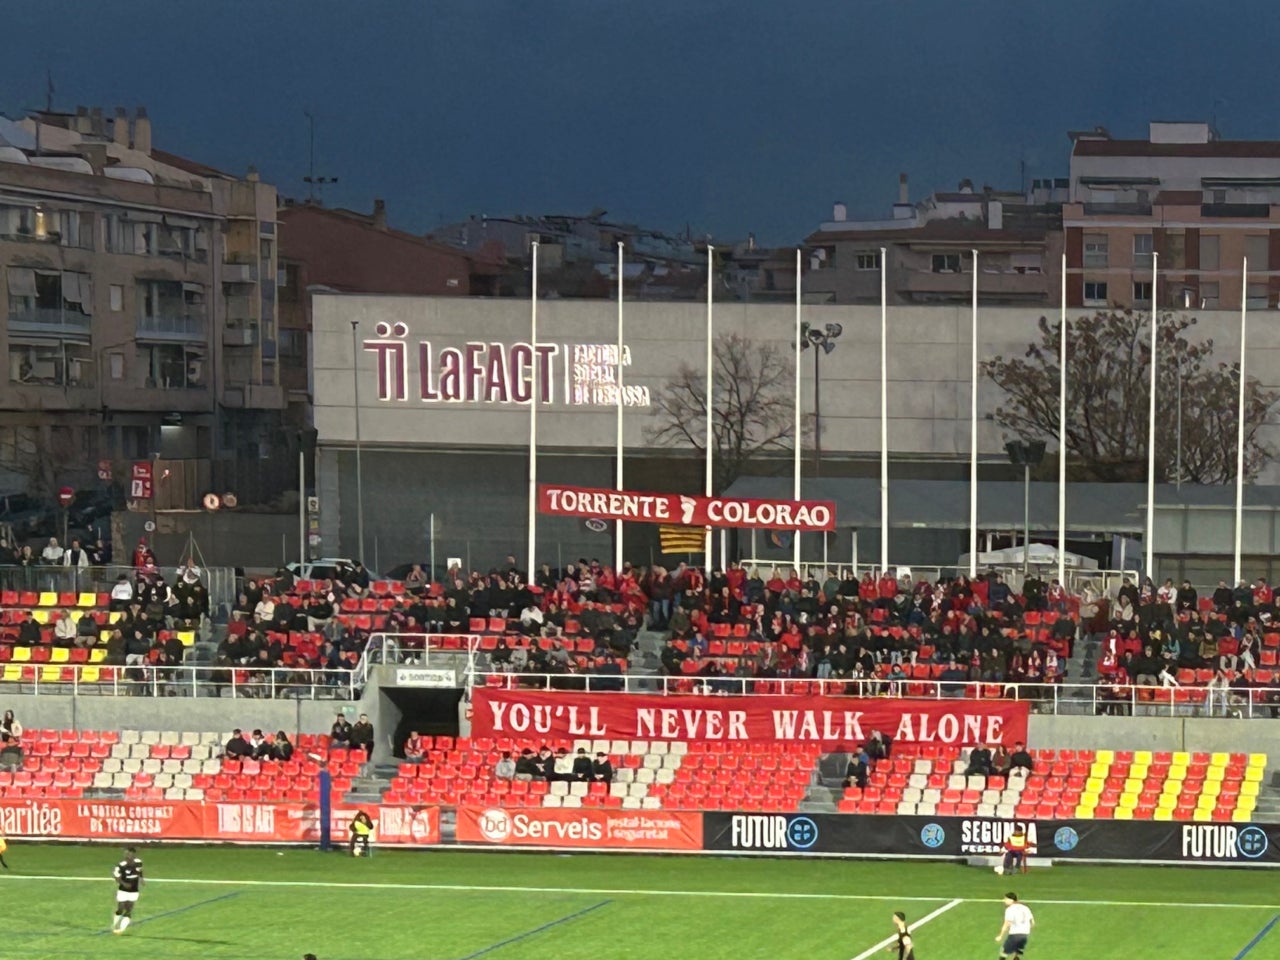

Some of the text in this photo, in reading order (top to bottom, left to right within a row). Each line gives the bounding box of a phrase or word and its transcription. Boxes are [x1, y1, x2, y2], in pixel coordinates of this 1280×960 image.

[419, 341, 558, 403] LaFACT
[547, 488, 830, 526] TORRENTE COLORAO
[488, 701, 1004, 744] YOU'LL NEVER WALK ALONE
[484, 815, 601, 840] bd Serveis
